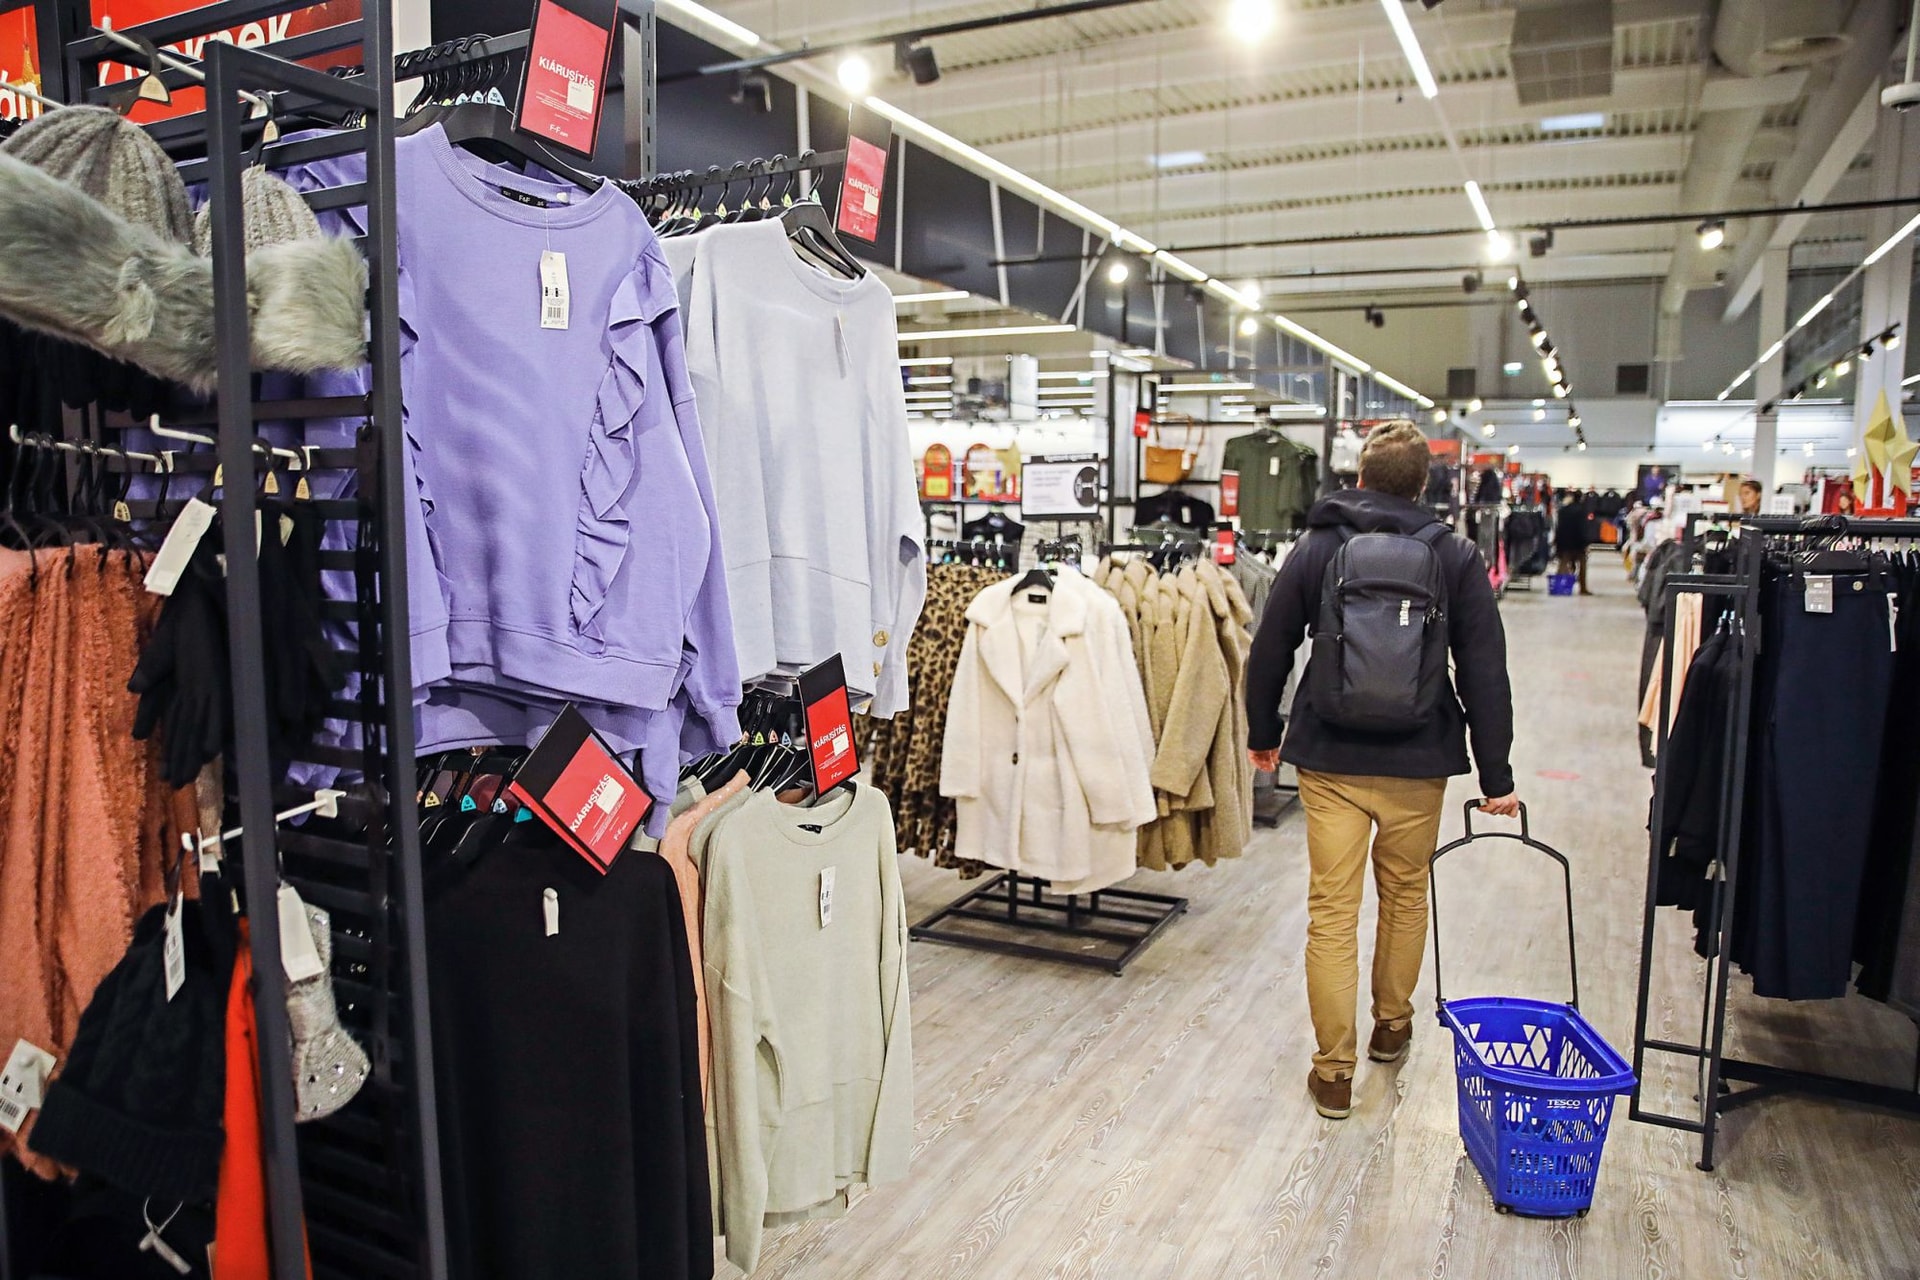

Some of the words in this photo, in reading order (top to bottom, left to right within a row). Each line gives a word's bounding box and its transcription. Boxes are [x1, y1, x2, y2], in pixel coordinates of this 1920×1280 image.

[538, 55, 595, 90] KIÁRUSÍTÁS
[813, 724, 847, 749] KIÁRUSÍTÁS
[569, 773, 612, 833] KIÁRUSÍTÁS
[1547, 1099, 1581, 1107] TESCO
